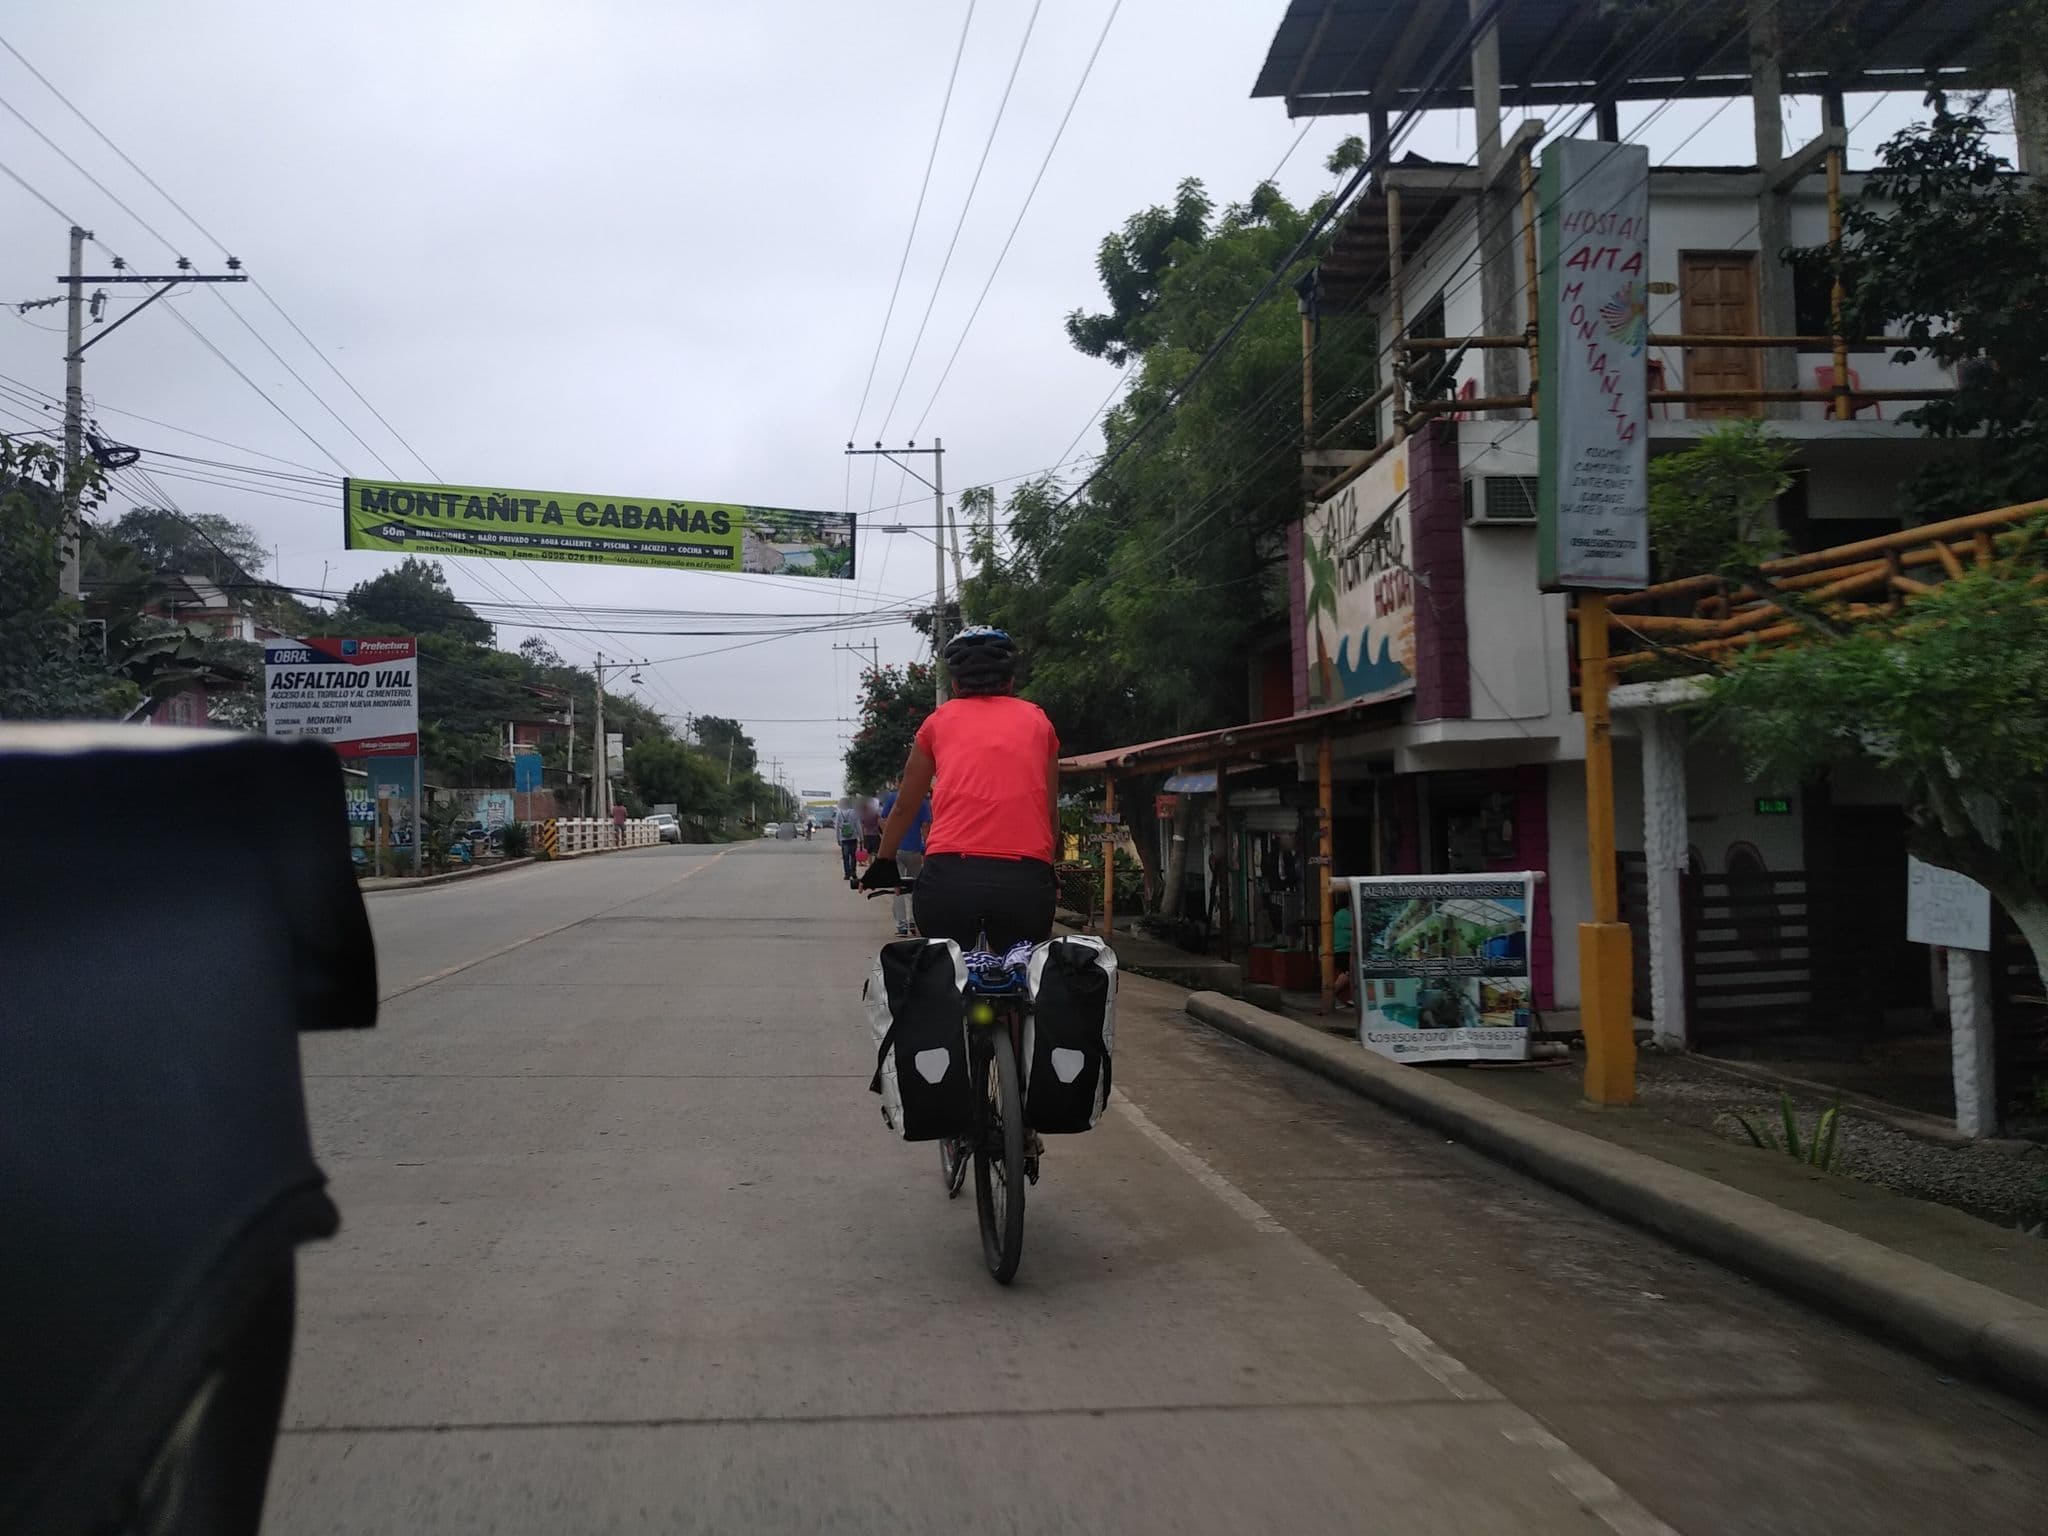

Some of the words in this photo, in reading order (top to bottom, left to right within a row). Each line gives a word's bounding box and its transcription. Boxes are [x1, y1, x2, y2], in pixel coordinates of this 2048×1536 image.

[1561, 281, 1637, 443] MONTAÑITA
[360, 488, 564, 525] MONTAÑITA
[576, 501, 731, 535] CABAÑAS
[382, 526, 406, 537] 50m
[415, 530, 466, 540] HABITACIONES
[478, 533, 497, 542] BAÑO
[499, 535, 530, 544] PRIVADO
[540, 537, 559, 546] AGUA
[560, 538, 593, 548] CALIENTE
[603, 541, 630, 551] PISCINA
[640, 544, 667, 553] JACUZZI
[678, 546, 703, 555] COCINA
[360, 641, 409, 651] Prefectura
[274, 651, 310, 663] OBRA:
[270, 671, 370, 690] ASFALTADO
[375, 670, 413, 688] VIAL
[271, 690, 299, 699] ACCESO
[307, 690, 315, 698] EL
[350, 690, 355, 698] Y
[356, 690, 364, 698] AL
[322, 701, 349, 709] SECTOR
[306, 714, 352, 724] MONTAÑITA
[1475, 884, 1522, 896] HOSTAL
